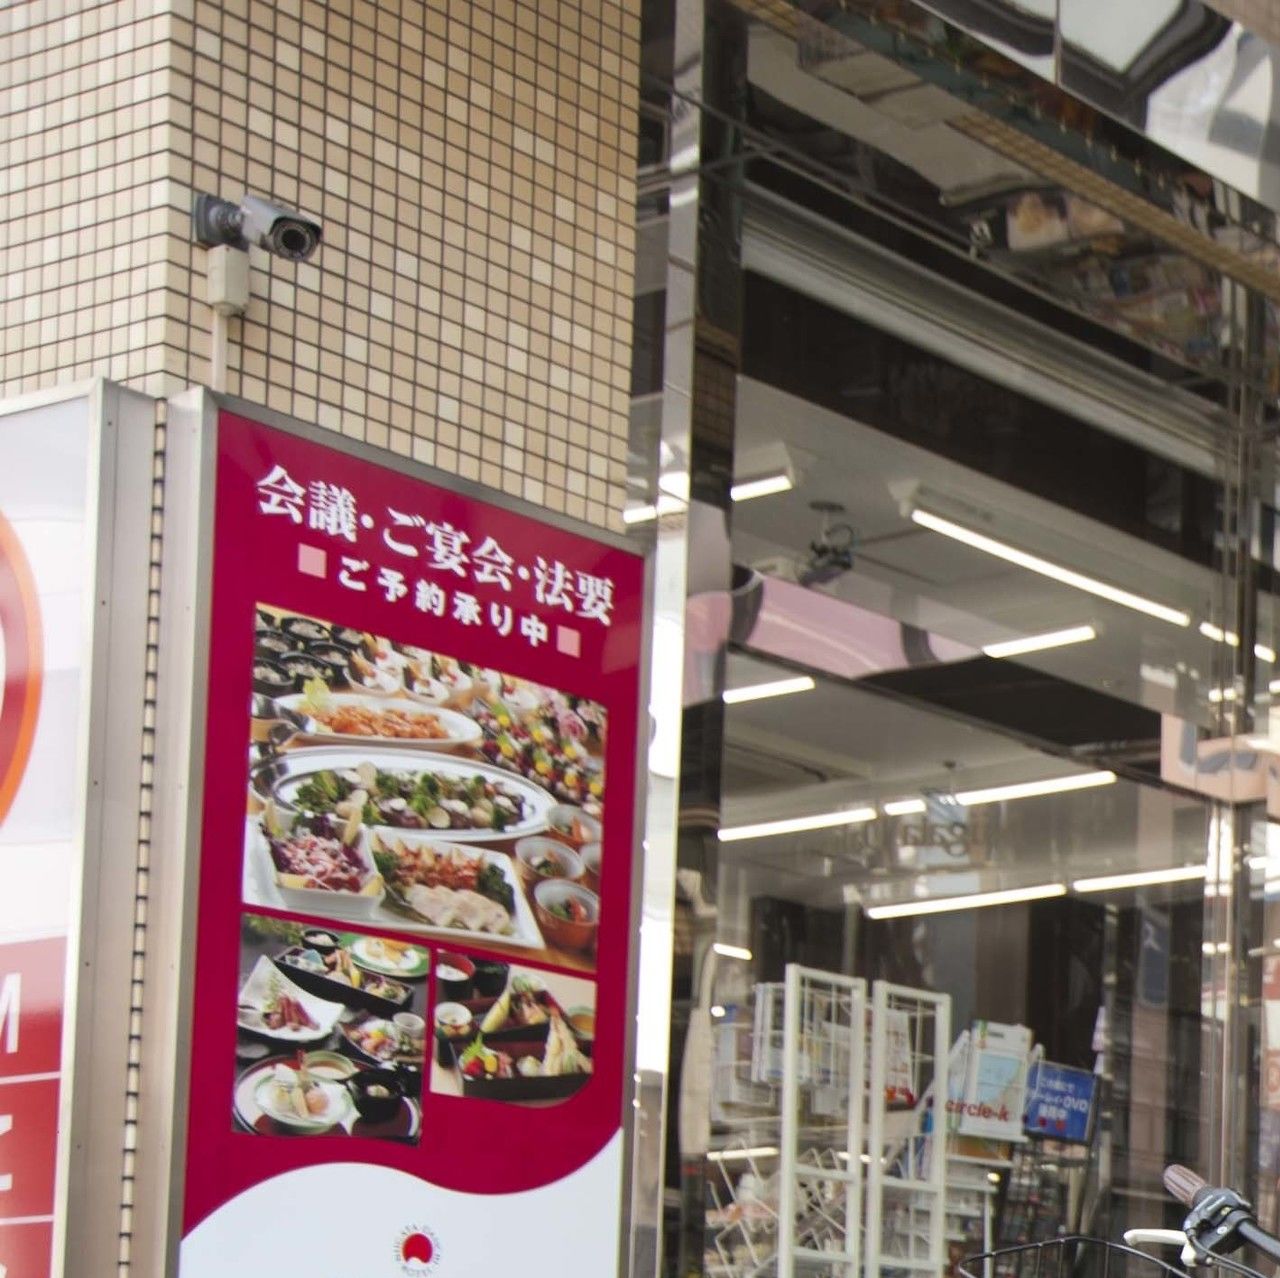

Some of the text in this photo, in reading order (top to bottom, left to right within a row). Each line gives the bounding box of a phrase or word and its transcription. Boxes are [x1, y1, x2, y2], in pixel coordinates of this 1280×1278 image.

[255, 464, 614, 626] 会議・ご宴会・法要
[338, 555, 549, 648] ご予約承り中
